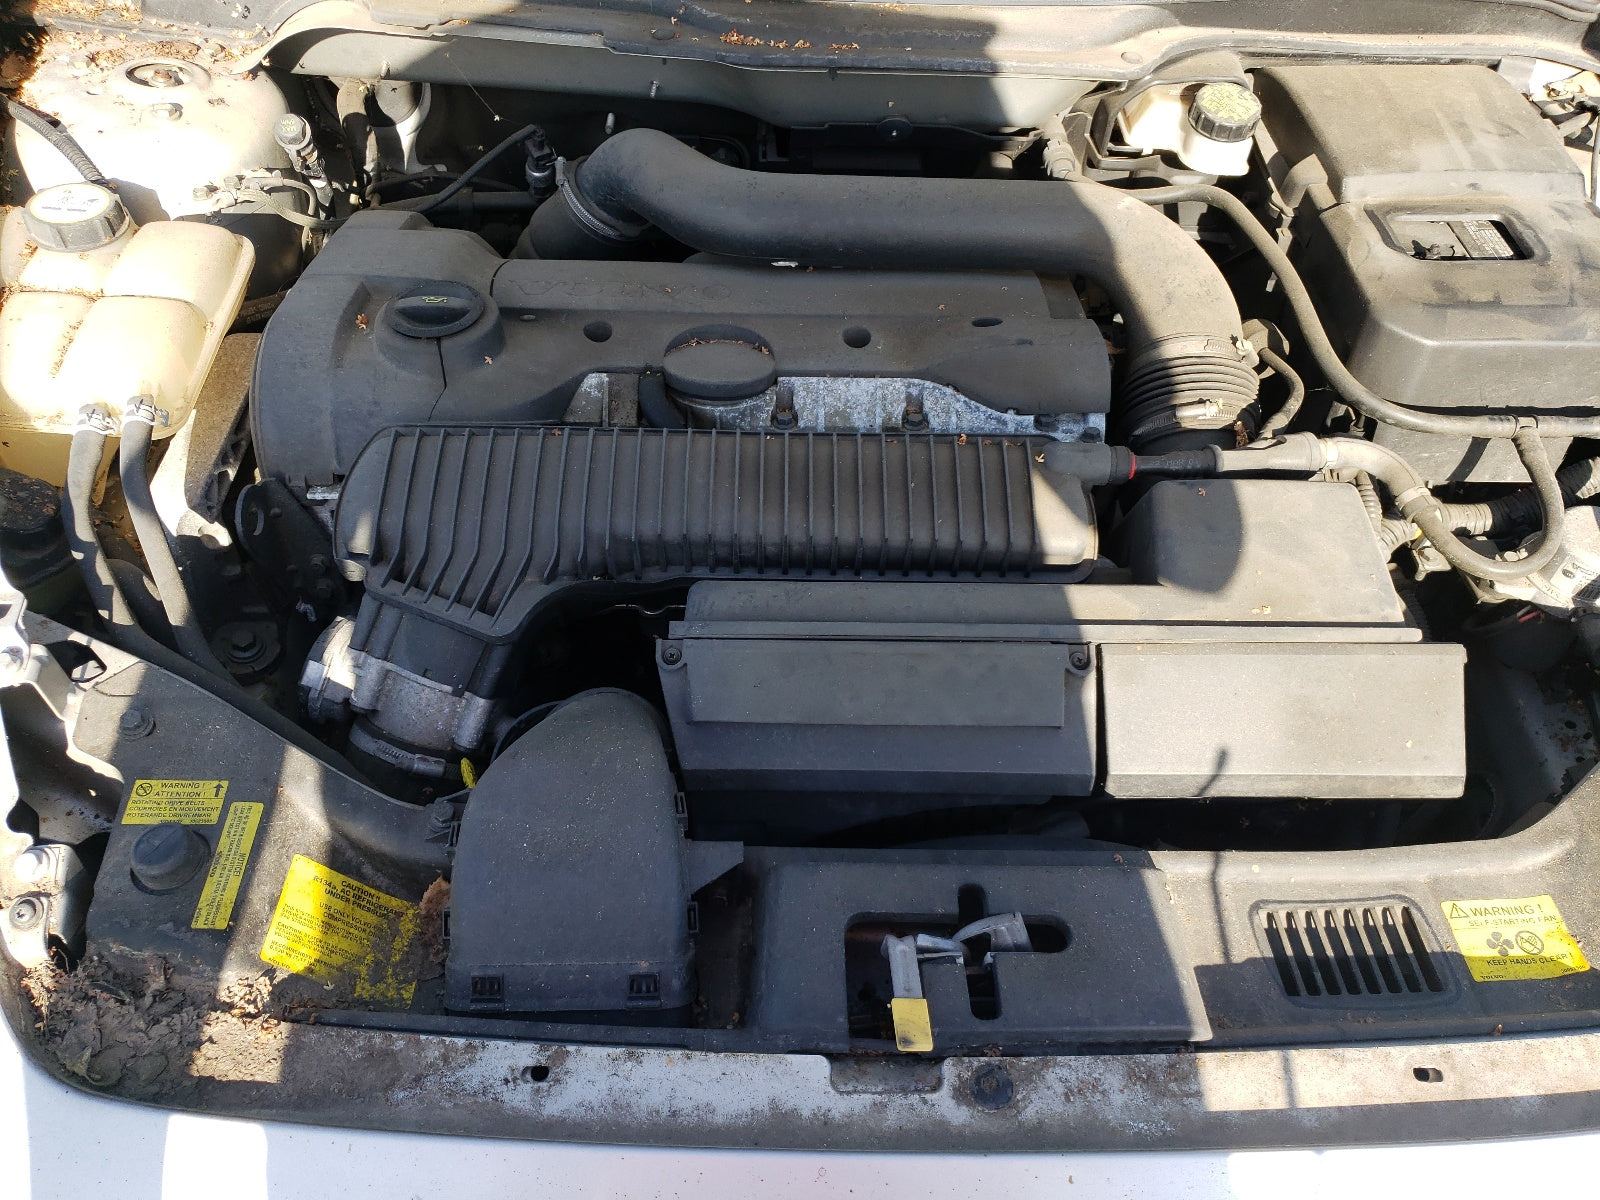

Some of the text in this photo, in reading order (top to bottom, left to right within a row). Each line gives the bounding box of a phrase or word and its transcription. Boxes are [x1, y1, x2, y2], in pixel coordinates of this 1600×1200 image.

[323, 887, 351, 904] UNDER
[339, 887, 351, 896] AC
[340, 880, 375, 899] CAUTION
[332, 907, 350, 918] ONLY
[1469, 904, 1535, 917] WARNING
[1538, 914, 1557, 924] FAN
[1486, 958, 1507, 967] KEEP
[1509, 957, 1537, 965] HANDS
[1538, 953, 1568, 963] CLEAR
